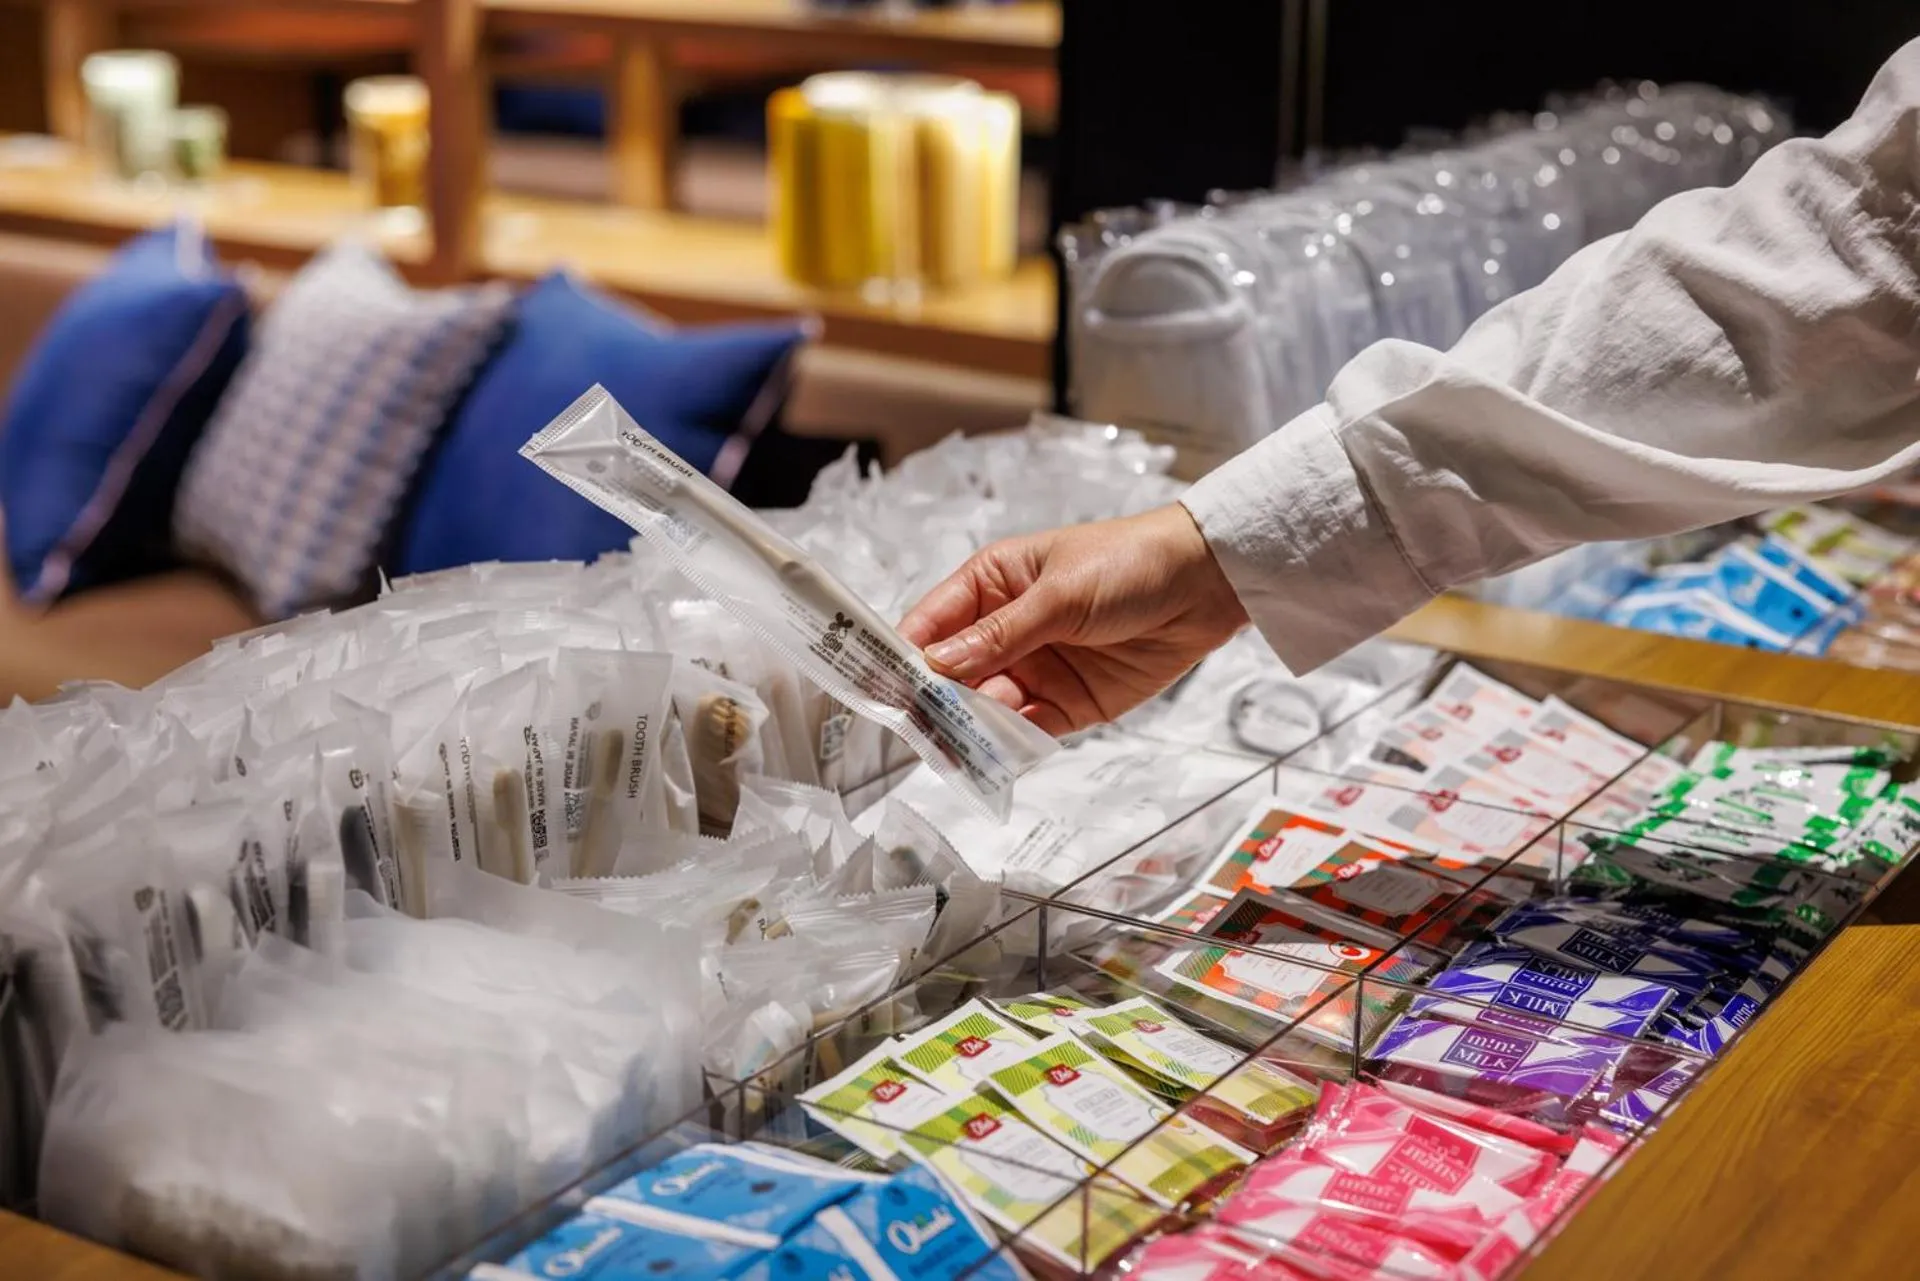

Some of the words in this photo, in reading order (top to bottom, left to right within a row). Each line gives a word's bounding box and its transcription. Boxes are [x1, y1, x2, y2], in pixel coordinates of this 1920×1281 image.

[634, 714, 648, 756] TOOTH
[627, 759, 641, 799] BRUSH
[1509, 990, 1561, 1016] MILK
[1454, 1047, 1508, 1070] MILK
